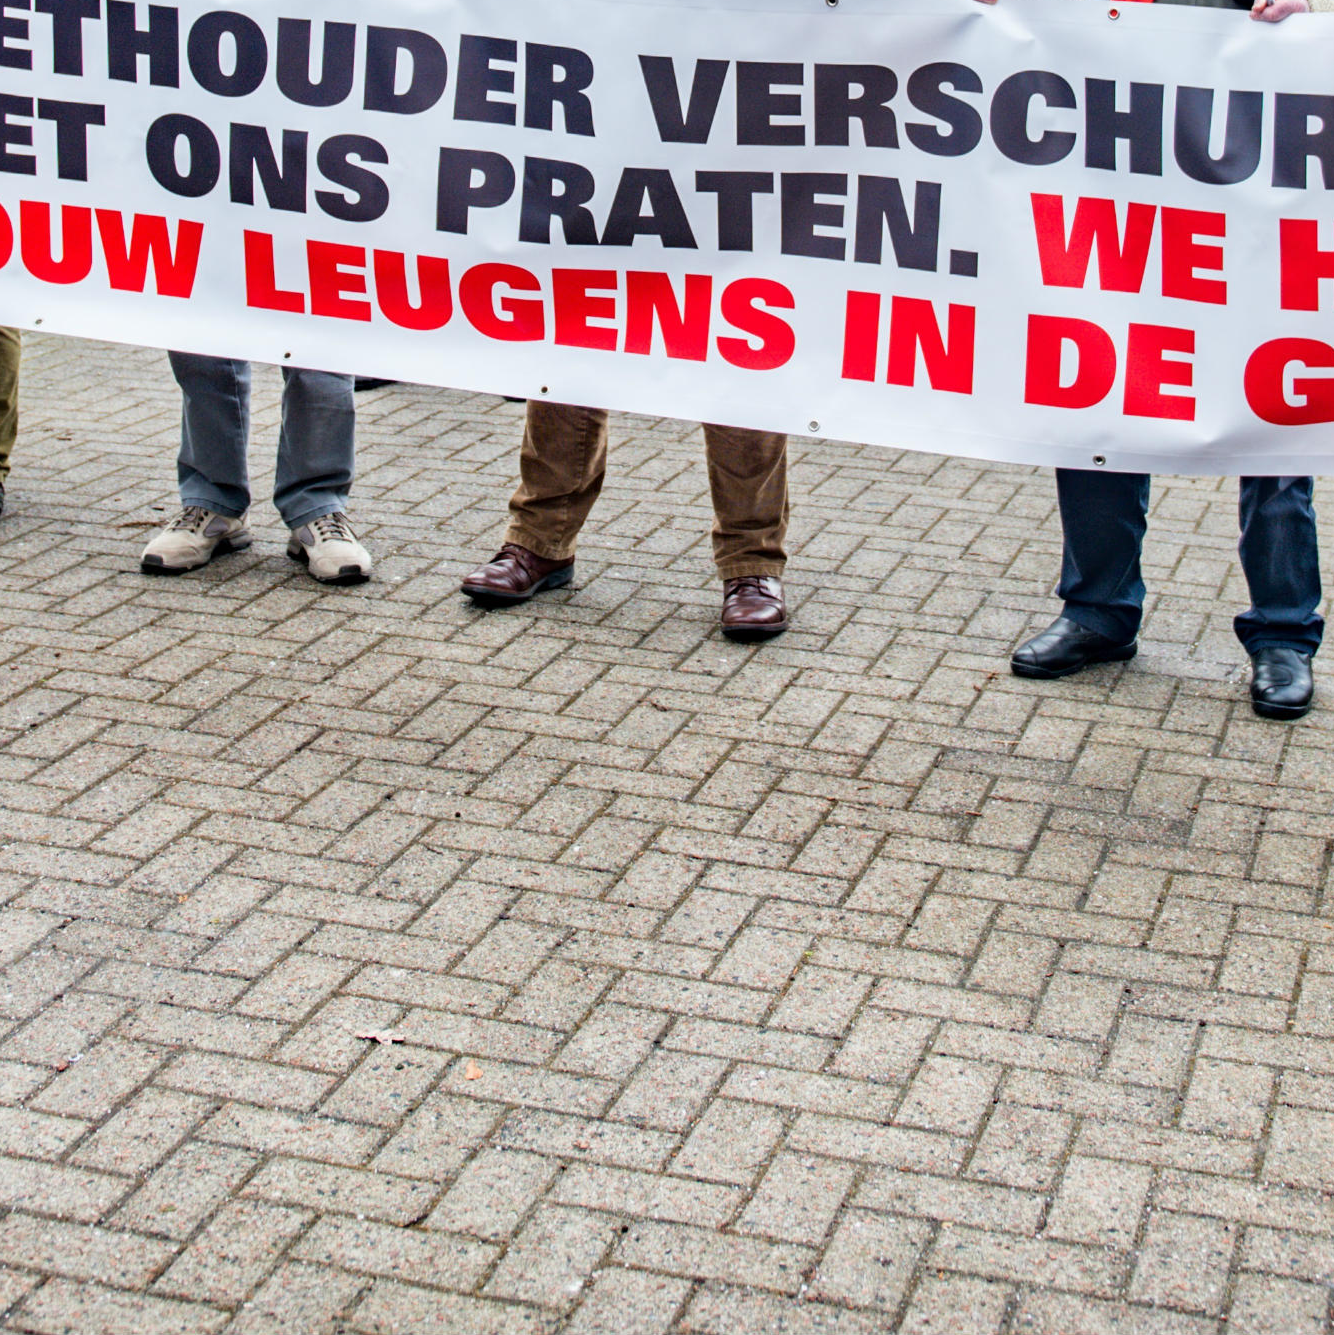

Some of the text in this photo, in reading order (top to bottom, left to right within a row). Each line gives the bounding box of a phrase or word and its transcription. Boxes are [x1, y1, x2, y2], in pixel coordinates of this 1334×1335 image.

[146, 113, 389, 222] ONS
[436, 146, 978, 278] PRATEN.
[1030, 193, 1227, 305] WE
[244, 229, 795, 371] LEUGENS
[842, 291, 975, 395] IN
[1024, 314, 1195, 421] DE
